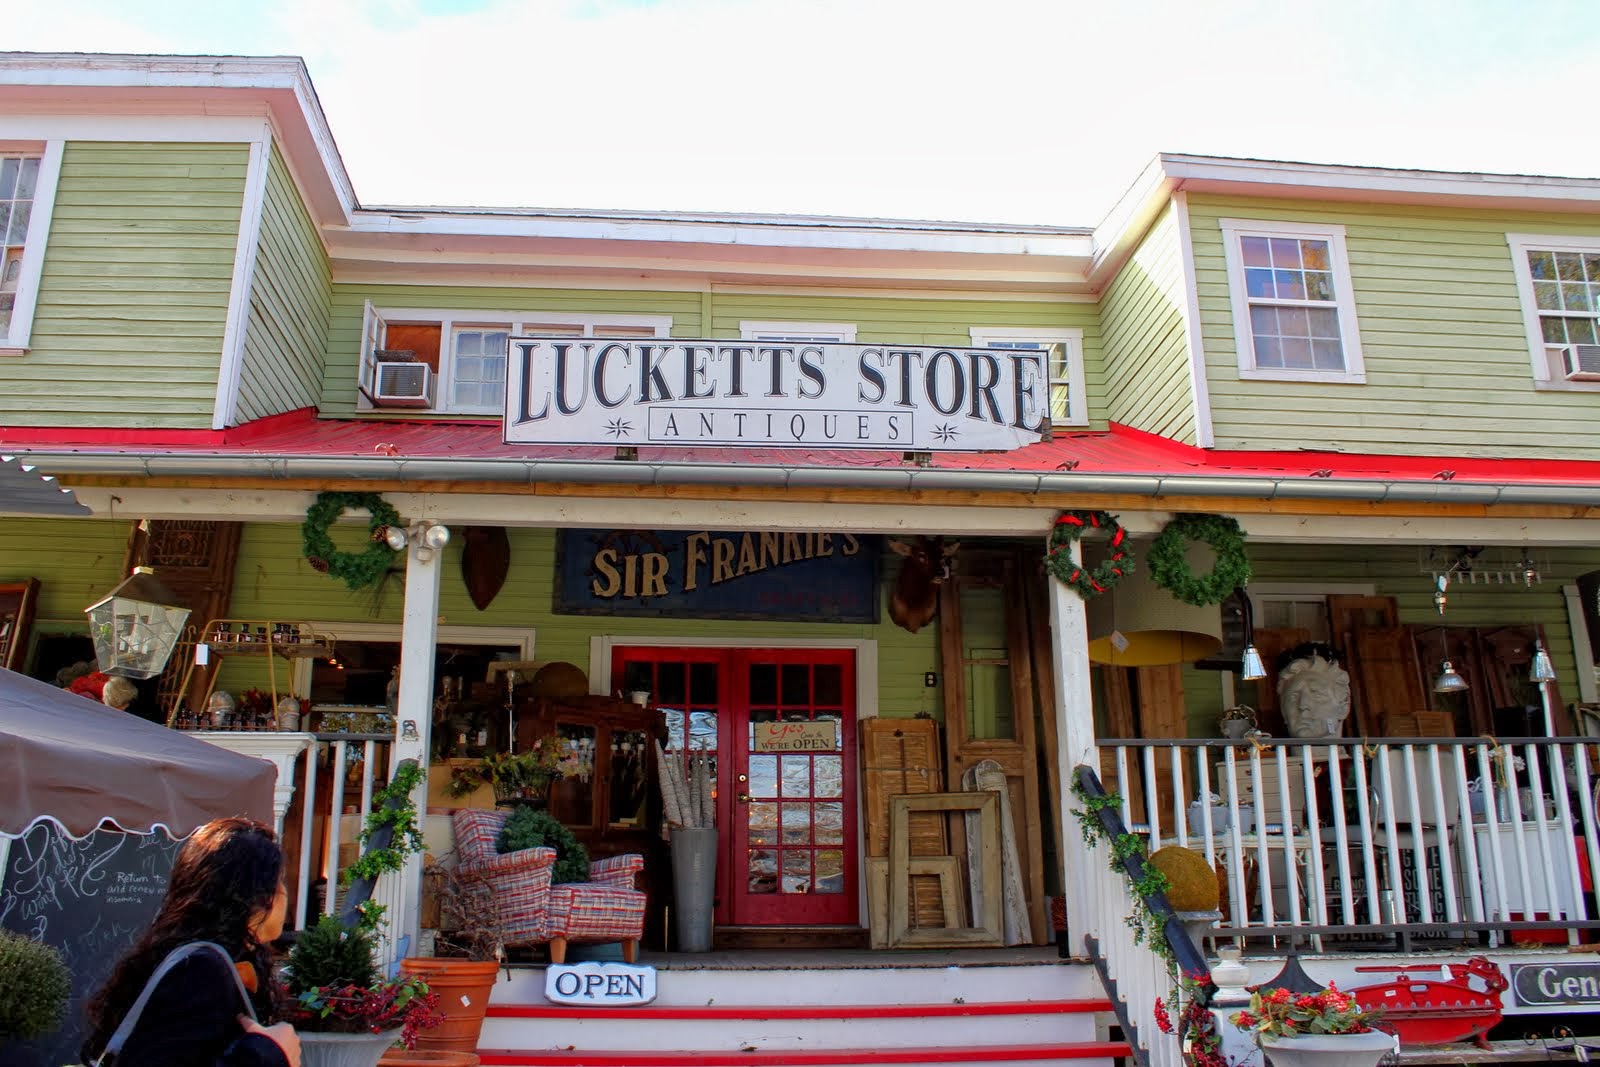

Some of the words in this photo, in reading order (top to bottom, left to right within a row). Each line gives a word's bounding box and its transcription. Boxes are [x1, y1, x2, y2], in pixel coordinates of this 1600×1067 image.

[512, 342, 827, 426] LUCKETTS
[858, 348, 1045, 433] STORE
[664, 412, 898, 441] ANTIQUES
[592, 549, 670, 597] SIR
[684, 531, 860, 591] FRANKIES
[762, 742, 790, 750] WE'RE
[793, 738, 830, 750] OPEN
[107, 884, 126, 894] and
[117, 871, 149, 884] Return
[555, 972, 646, 999] OPEN
[1538, 967, 1600, 998] Gen
